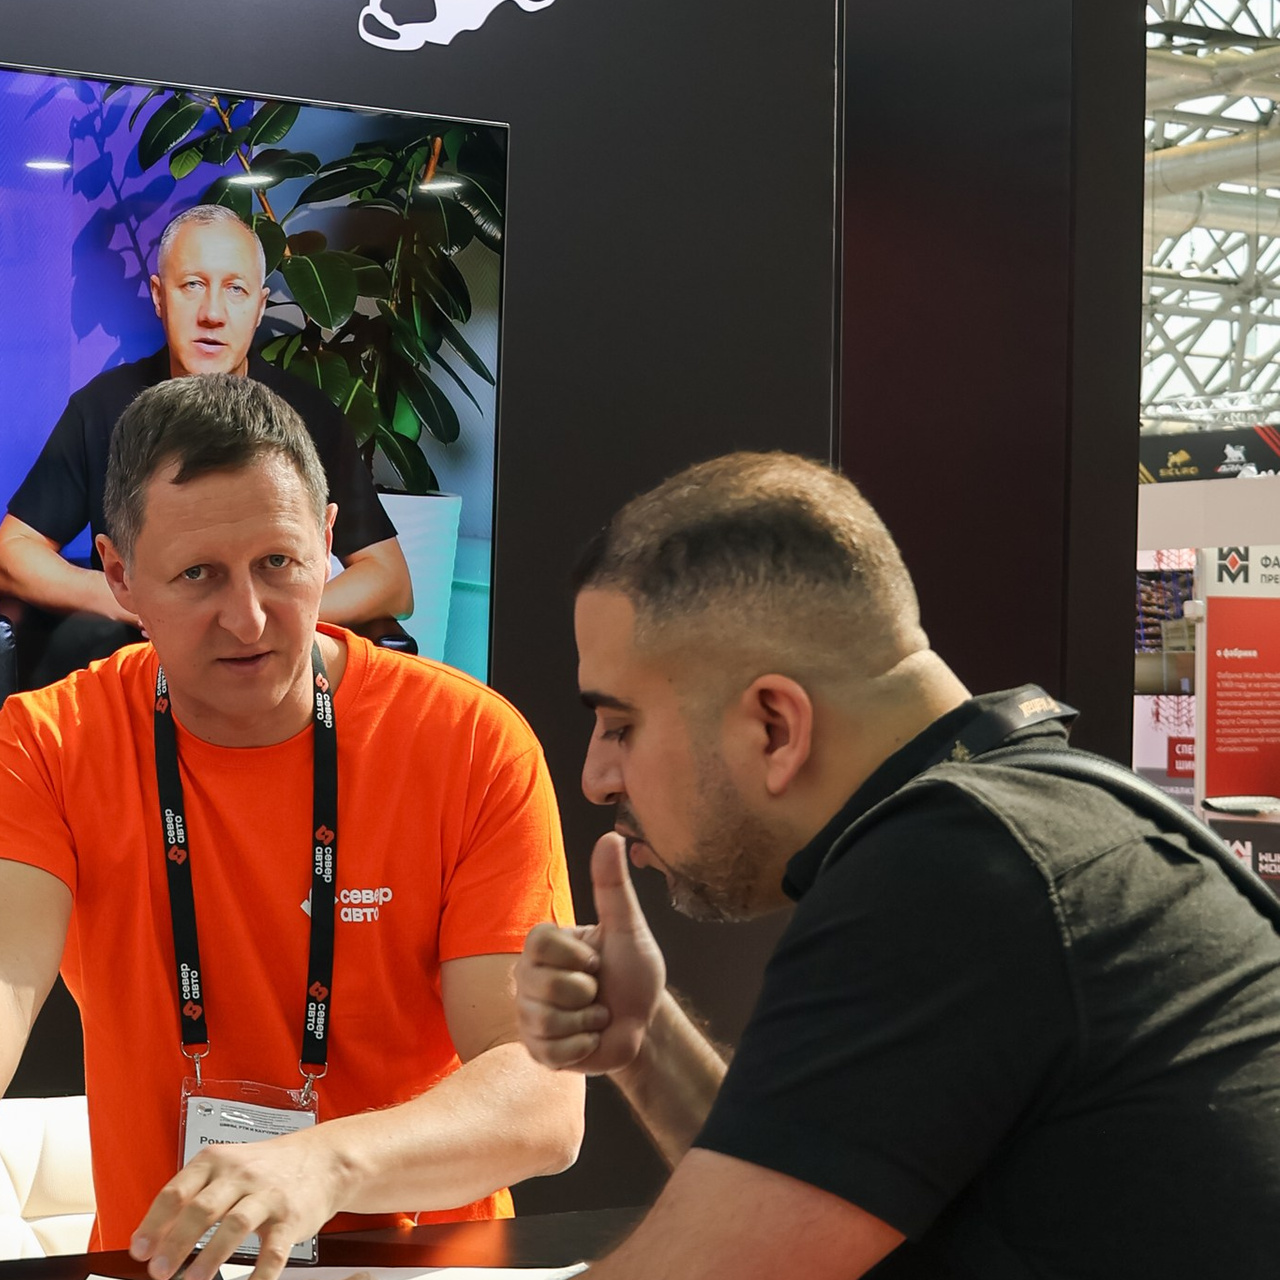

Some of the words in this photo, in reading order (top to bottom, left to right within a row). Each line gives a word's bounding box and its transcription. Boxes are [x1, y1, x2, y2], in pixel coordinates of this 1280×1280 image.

[316, 692, 324, 720] авто
[165, 808, 176, 845] север
[174, 815, 185, 844] авто
[315, 846, 323, 875] авто
[322, 846, 333, 883] север
[180, 963, 191, 1000] север
[190, 970, 200, 999] авто
[307, 1002, 317, 1031] авто
[313, 1003, 326, 1040] север
